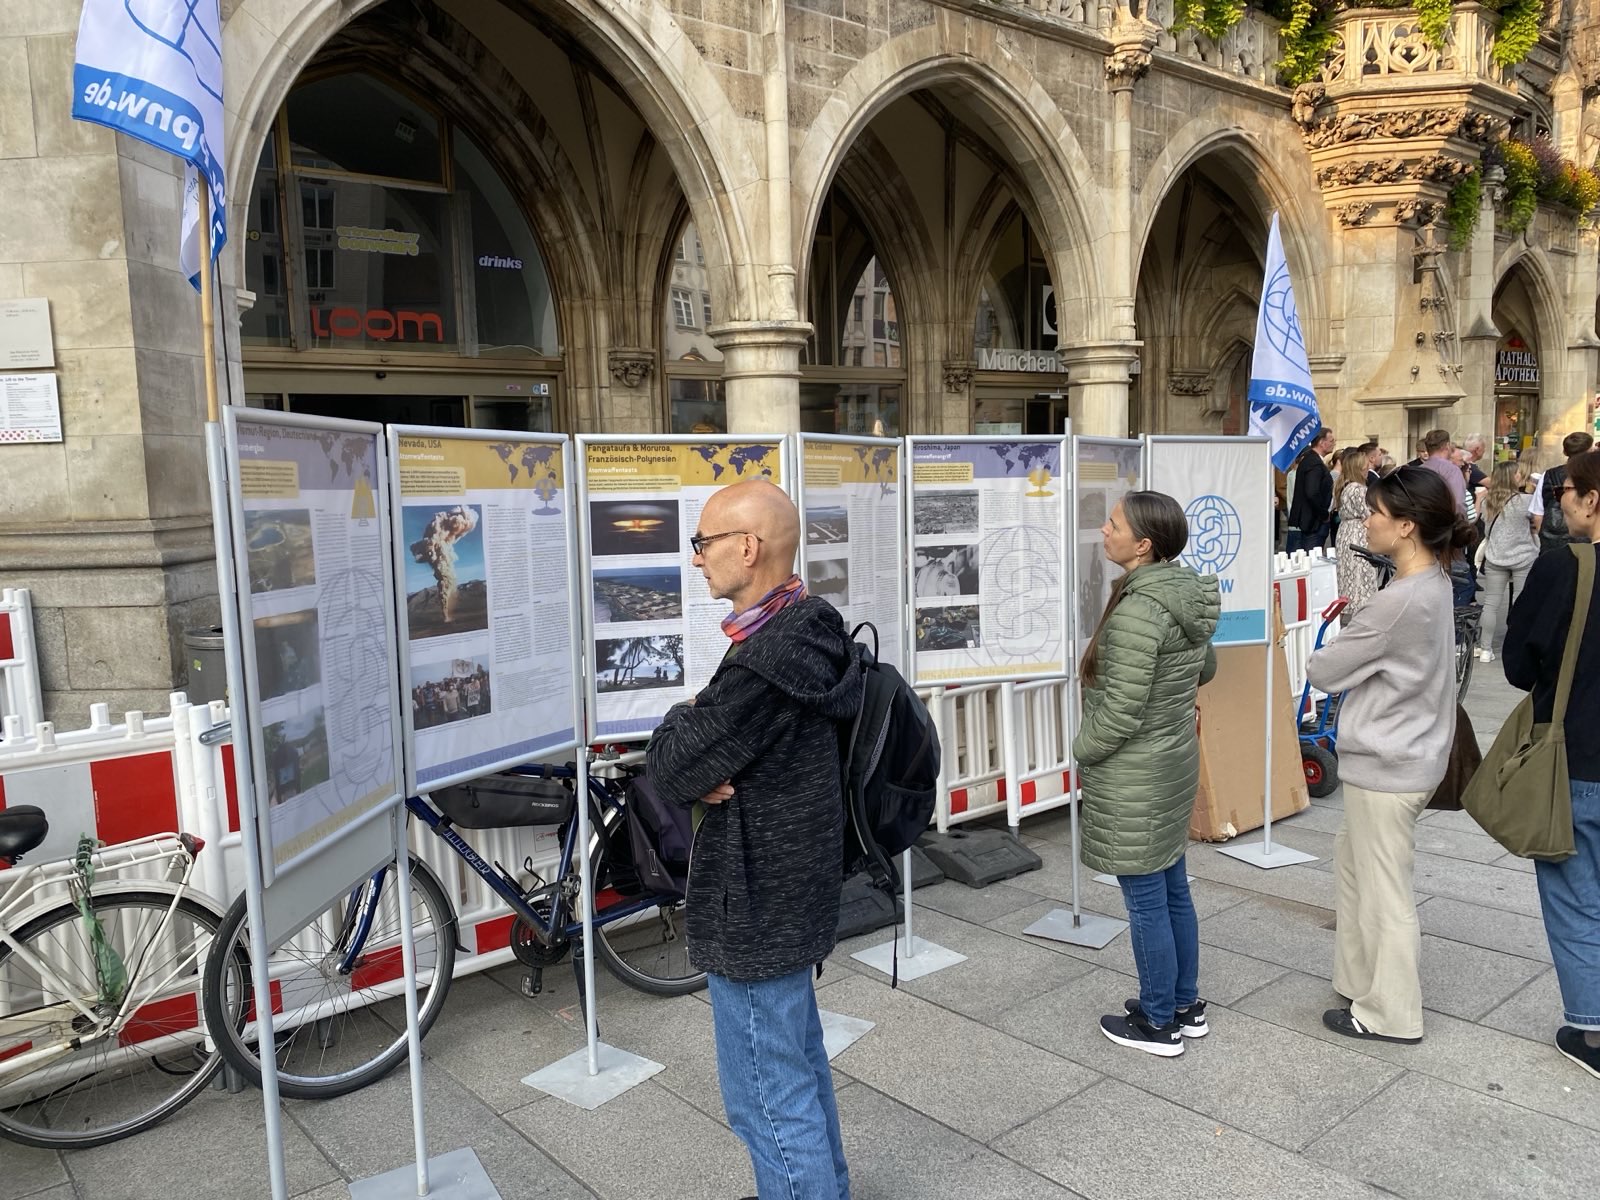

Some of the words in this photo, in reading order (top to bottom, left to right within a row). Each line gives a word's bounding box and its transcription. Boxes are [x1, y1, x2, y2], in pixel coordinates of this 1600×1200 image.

[479, 255, 523, 270] drinks
[980, 349, 1056, 372] München
[1500, 351, 1537, 367] RATHAUS
[399, 439, 427, 448] Nevada,
[428, 440, 442, 448] USA
[913, 444, 942, 452] Hiroshima,
[944, 444, 961, 452] Japan
[588, 444, 631, 454] Fangataufa
[640, 445, 672, 453] Moruroa,
[588, 455, 677, 464] Französisch-Polynesien
